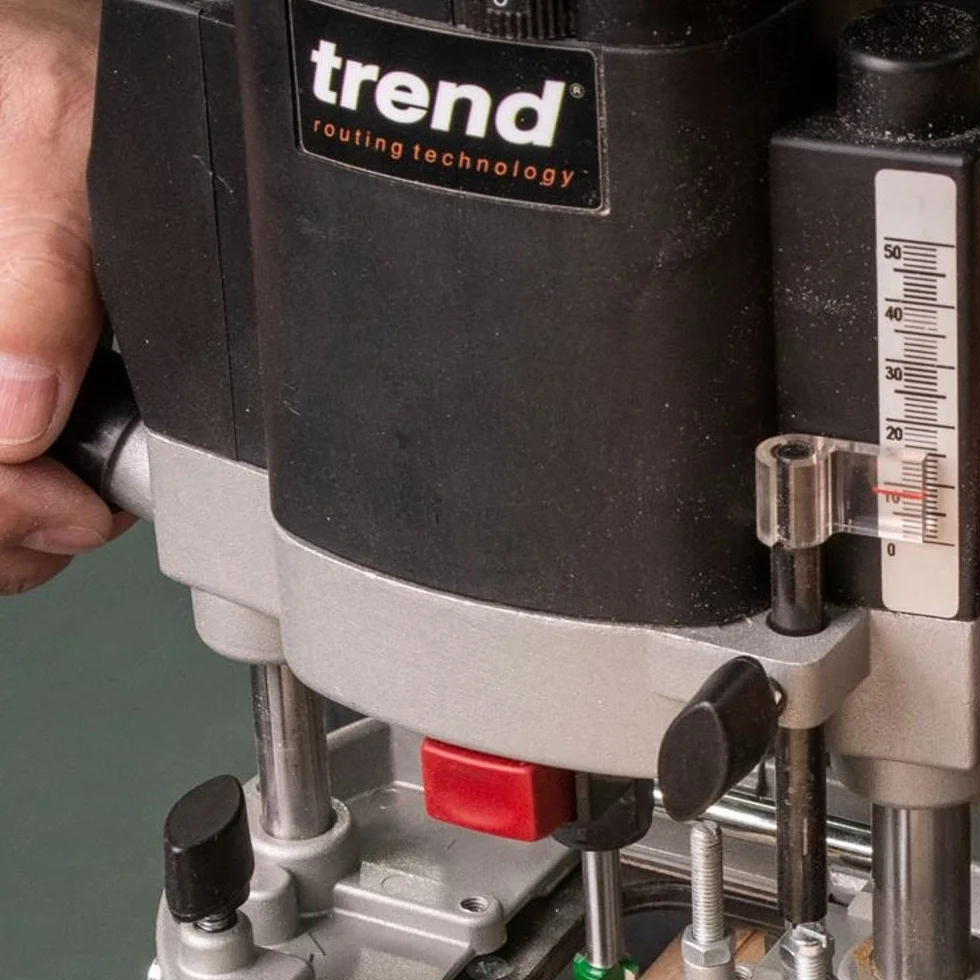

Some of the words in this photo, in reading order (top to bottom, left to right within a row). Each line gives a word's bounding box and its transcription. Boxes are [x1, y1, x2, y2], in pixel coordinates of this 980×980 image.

[313, 118, 404, 160] routing
[413, 143, 575, 187] technology
[884, 244, 902, 260] 50
[885, 306, 903, 321] 40
[885, 366, 903, 381] 30
[886, 426, 903, 441] 20
[887, 543, 896, 557] 0
